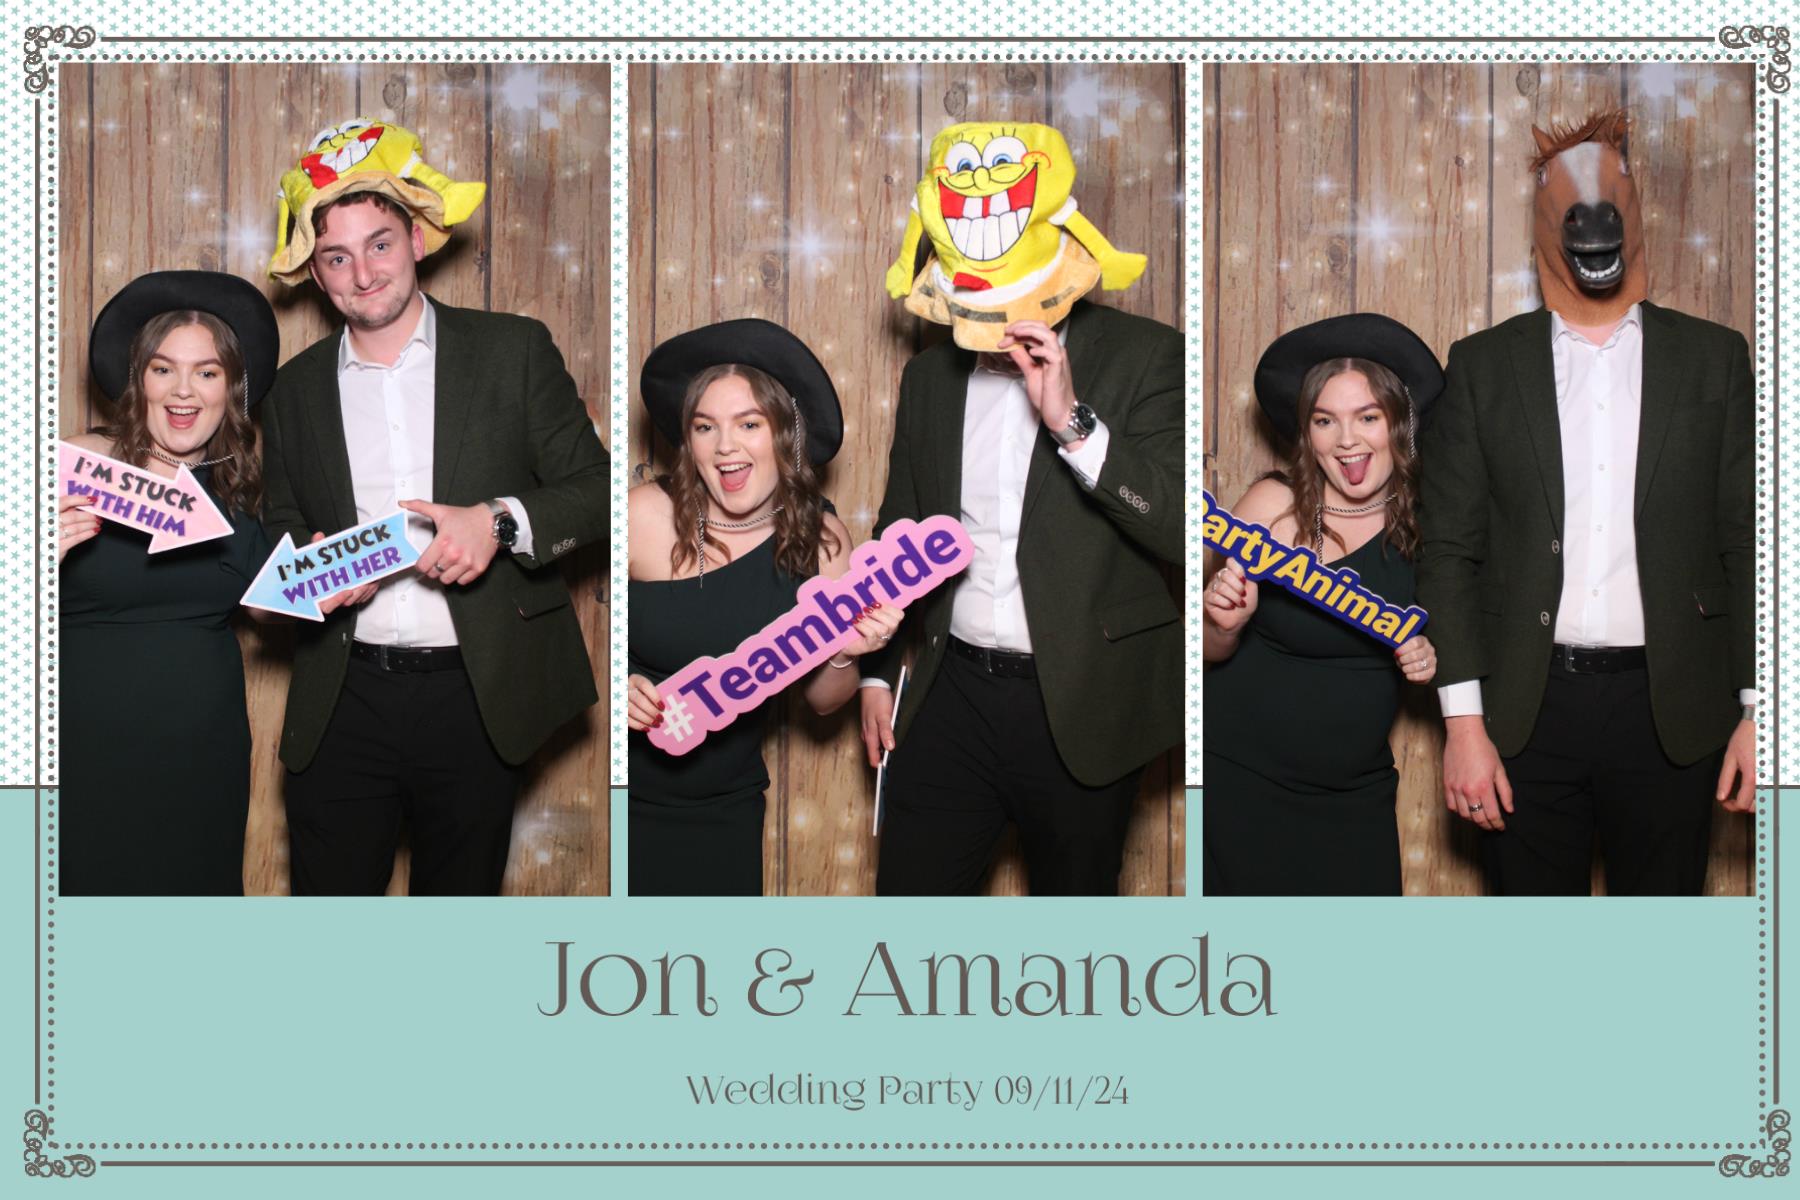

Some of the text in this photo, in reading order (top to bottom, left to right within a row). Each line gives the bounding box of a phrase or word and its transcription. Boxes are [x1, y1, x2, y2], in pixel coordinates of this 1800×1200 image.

[67, 480, 185, 537] WITH HIM
[73, 456, 197, 512] I'M STUCK
[277, 524, 391, 581] I'M STUCK
[282, 547, 402, 604] WITH HER
[662, 529, 961, 743] #Teambride
